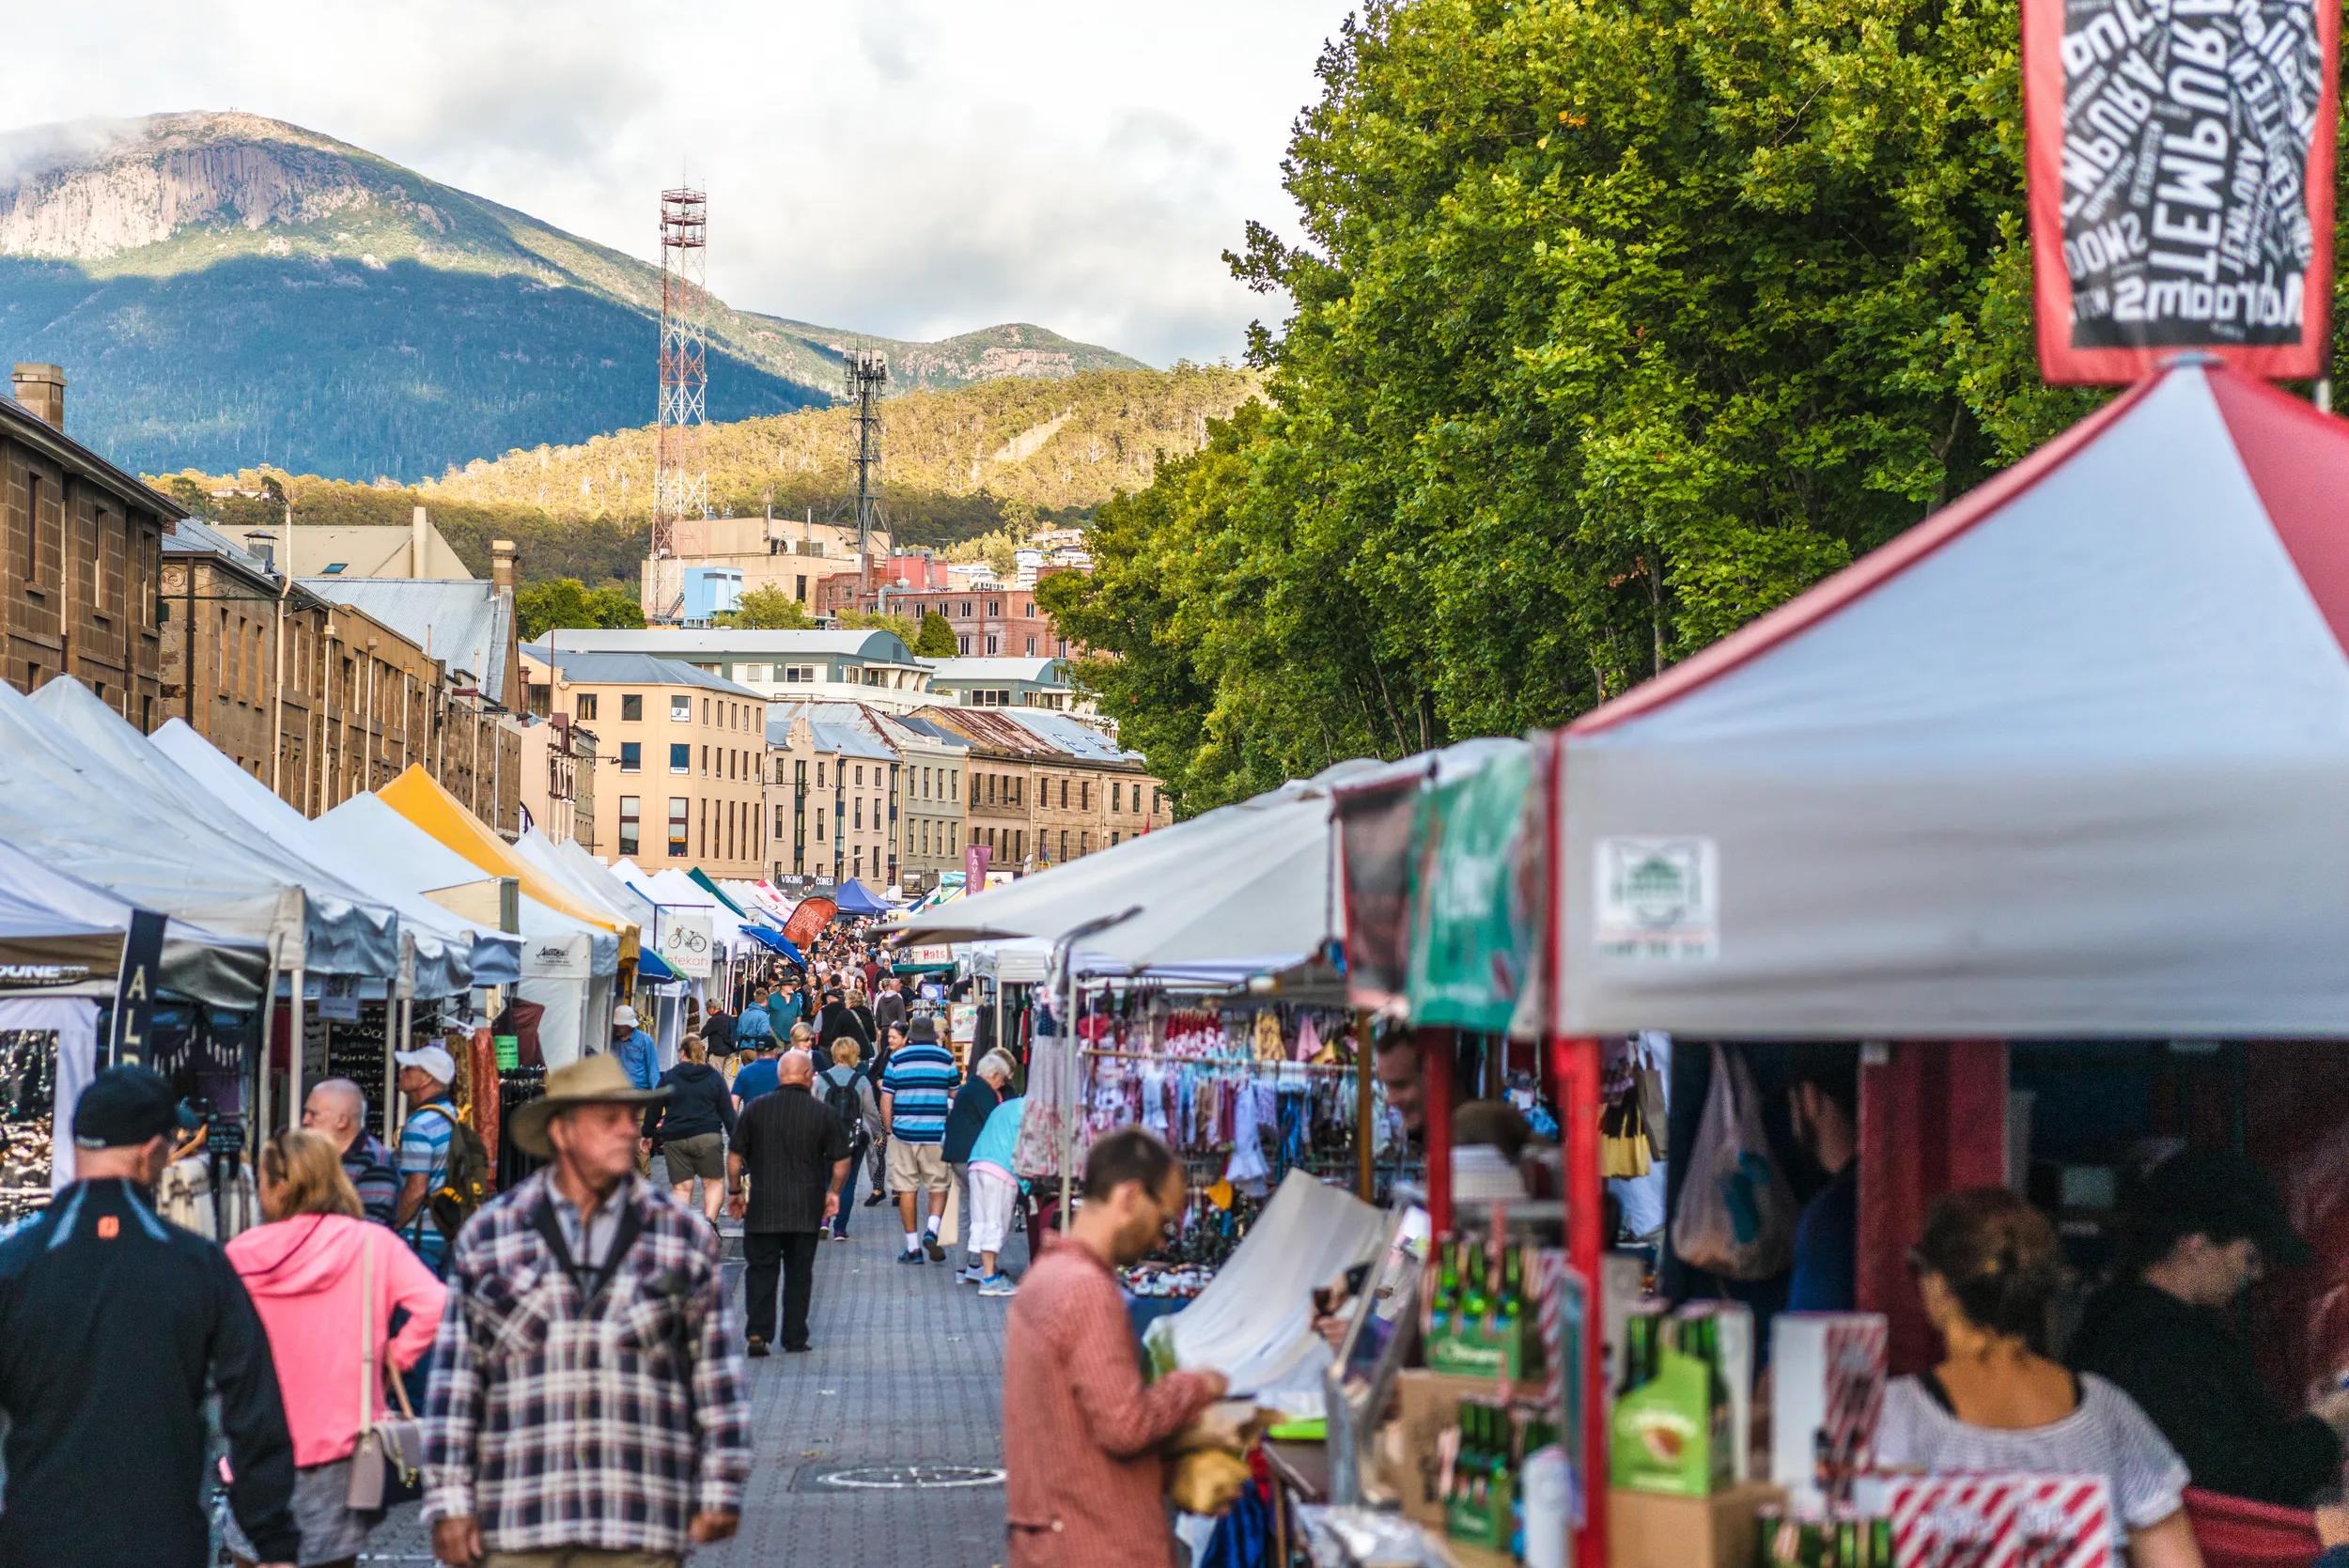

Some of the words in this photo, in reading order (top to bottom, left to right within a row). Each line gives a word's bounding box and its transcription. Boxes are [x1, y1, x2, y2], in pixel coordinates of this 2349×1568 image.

[781, 875, 803, 884] VIKING
[816, 877, 834, 886] CONES
[924, 950, 946, 960] Hats
